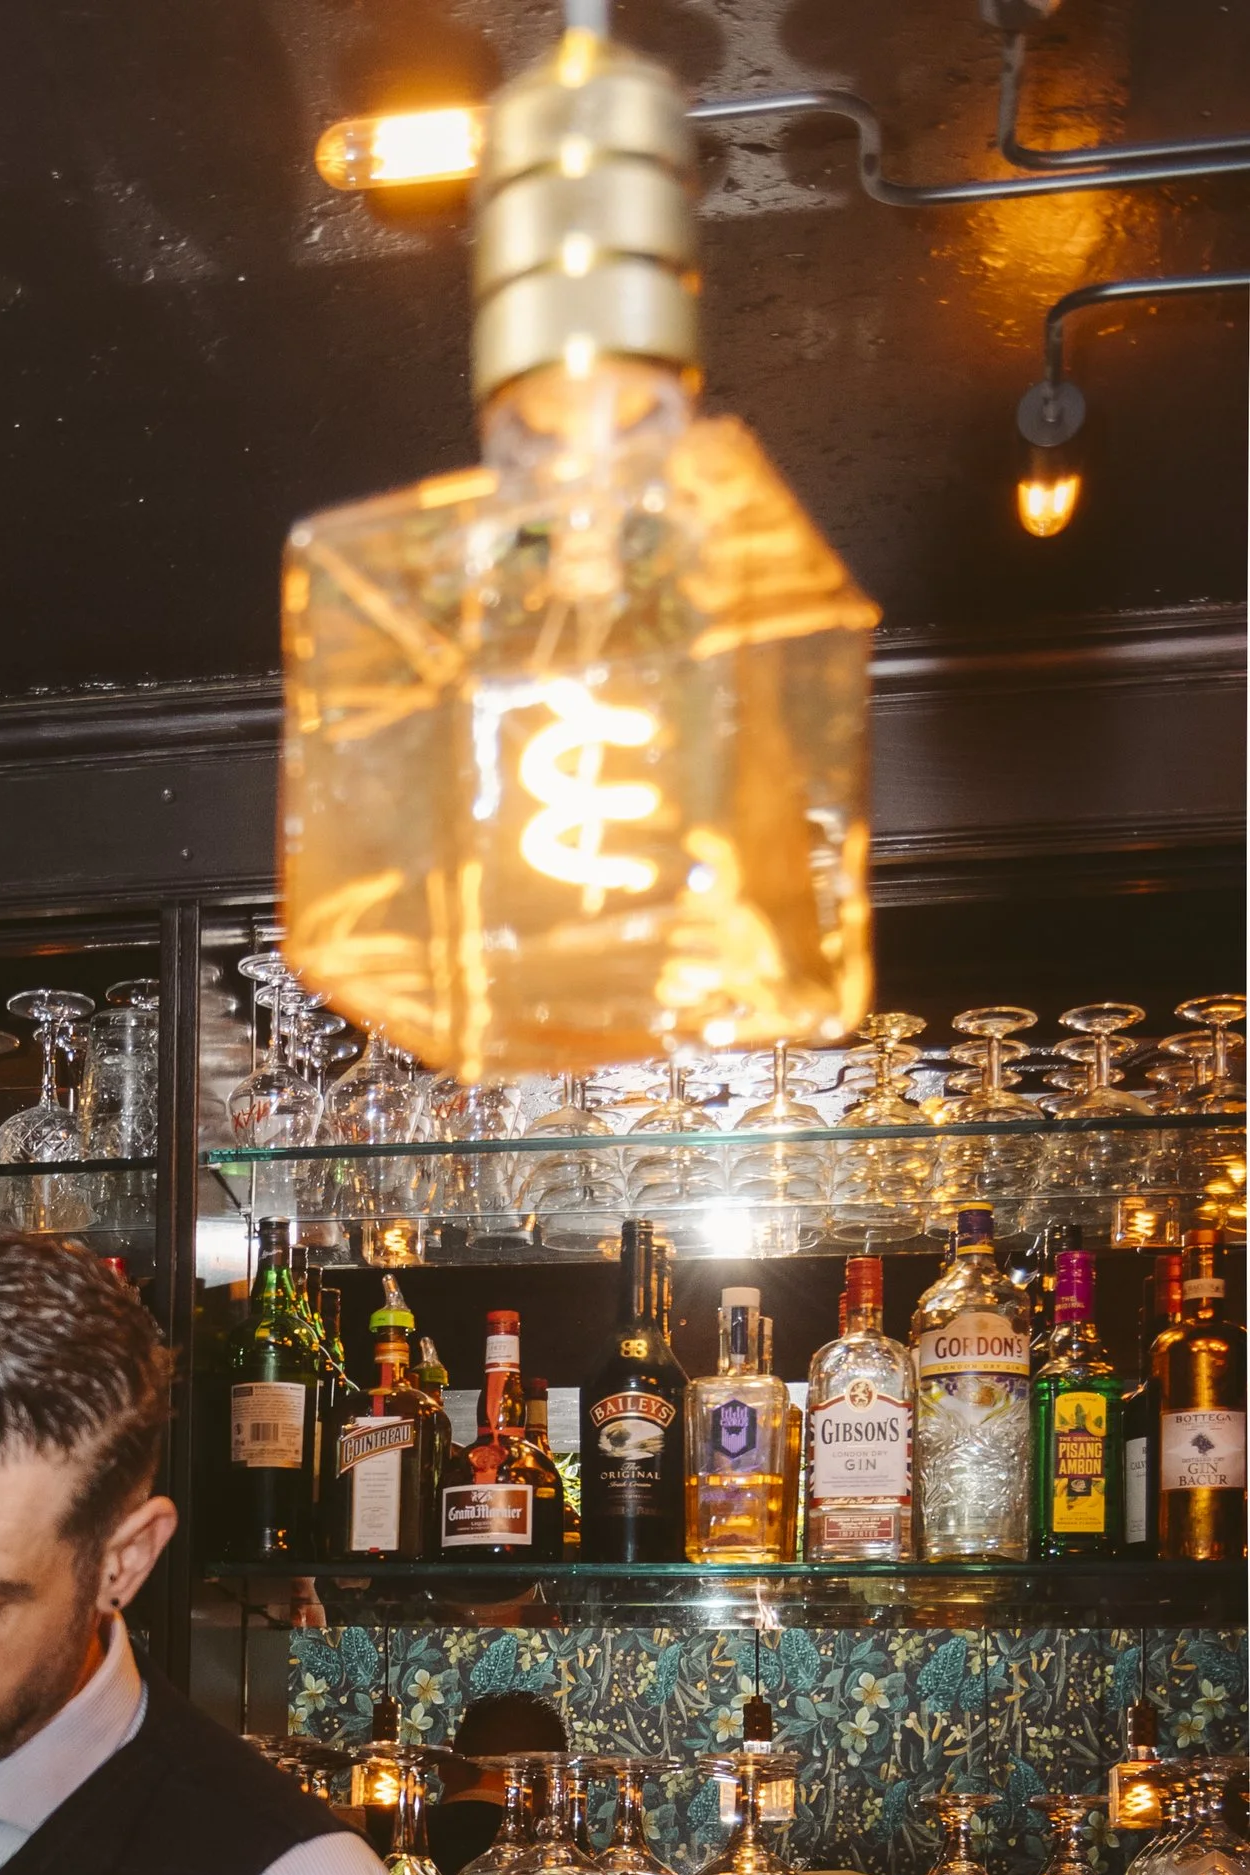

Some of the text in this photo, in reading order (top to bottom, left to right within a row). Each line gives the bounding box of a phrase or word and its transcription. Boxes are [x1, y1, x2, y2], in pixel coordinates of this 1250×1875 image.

[935, 1336, 1023, 1359] GORDON'S
[594, 1397, 670, 1421] BAILEYS
[1175, 1413, 1232, 1424] BOTTEGA
[821, 1417, 900, 1445] GIBSON'S
[343, 1425, 412, 1464] COINTREAU
[1058, 1442, 1102, 1459] PISANG
[845, 1459, 877, 1471] GIN
[1058, 1458, 1101, 1475] AMBON
[1188, 1462, 1219, 1475] GIN
[600, 1470, 661, 1480] ORIGINAL
[1178, 1474, 1228, 1487] BACUR
